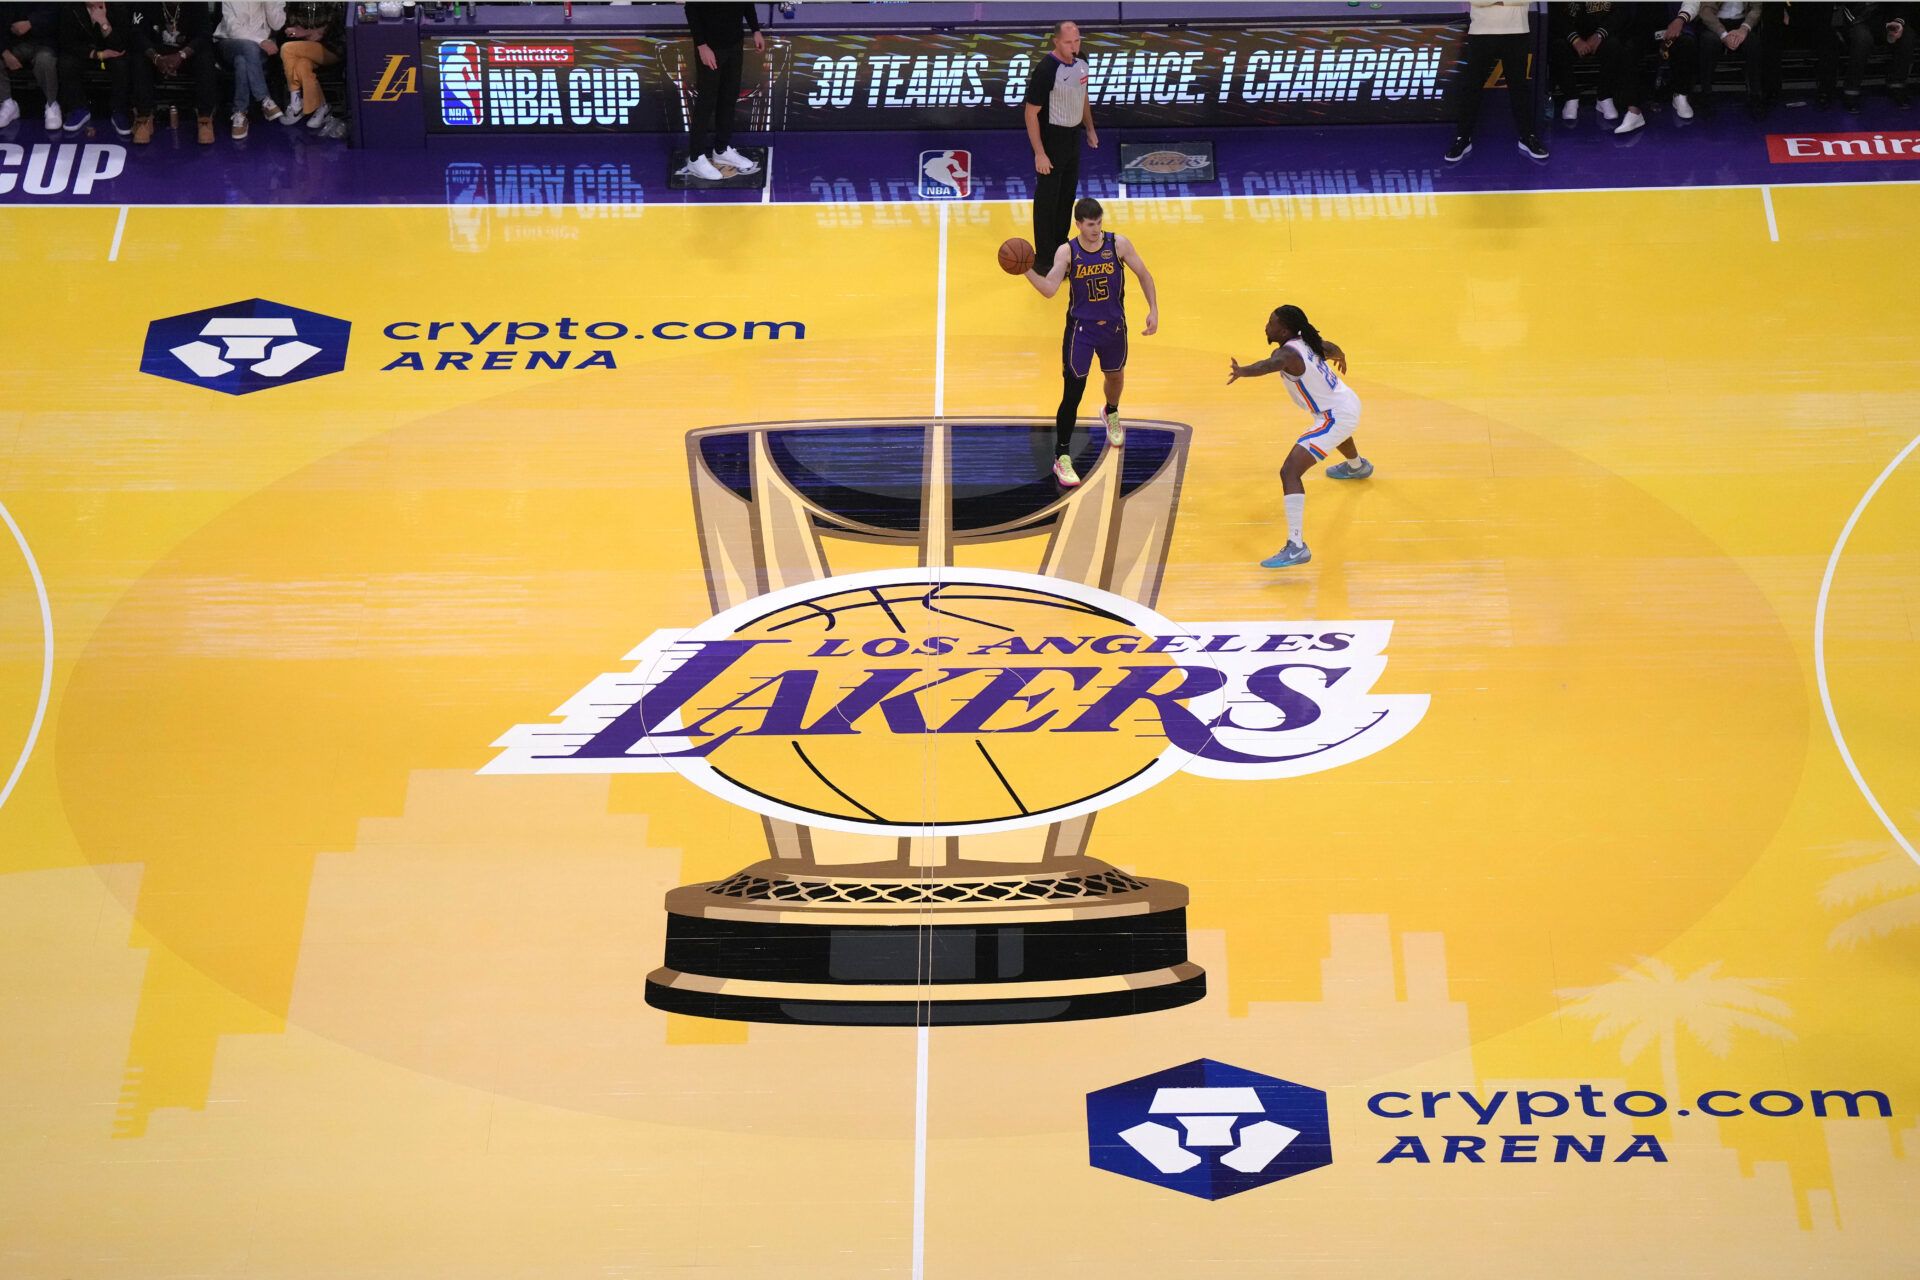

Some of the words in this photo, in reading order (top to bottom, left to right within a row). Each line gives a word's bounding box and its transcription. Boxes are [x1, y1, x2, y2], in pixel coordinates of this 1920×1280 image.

[493, 46, 569, 62] Emirates
[362, 54, 418, 101] LA
[808, 55, 858, 109] 30
[867, 54, 993, 108] TEAMS.
[1003, 53, 1031, 107] 8
[1087, 51, 1205, 105] VANCE.
[1218, 51, 1237, 103] 1
[1242, 47, 1444, 103] CHAMPION.
[488, 69, 564, 125] NBA
[568, 68, 640, 125] CUP
[448, 108, 469, 121] NBA
[926, 186, 951, 196] NBA
[1075, 262, 1115, 279] LAKERS
[1087, 277, 1110, 302] 15
[383, 317, 806, 345] crypto.com
[380, 350, 619, 371] ARENA
[808, 635, 961, 658] LOS
[977, 632, 1357, 656] ANGELES
[530, 638, 1390, 763] LAKERS
[1367, 1084, 1893, 1125] crypto.com
[1376, 1134, 1669, 1164] ARENA
